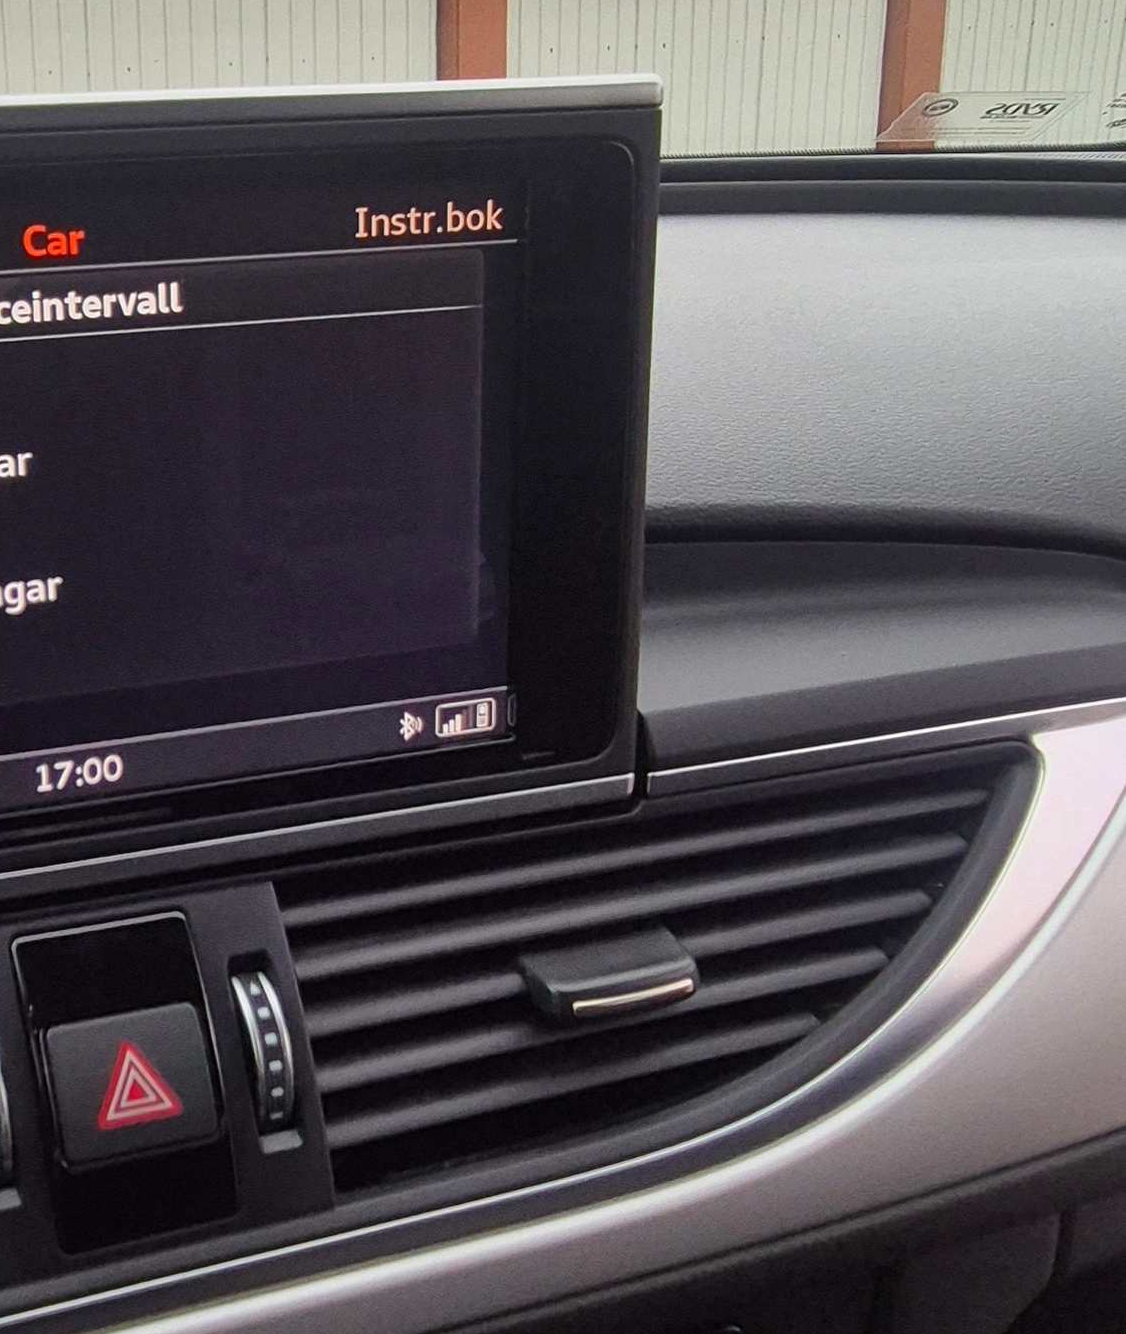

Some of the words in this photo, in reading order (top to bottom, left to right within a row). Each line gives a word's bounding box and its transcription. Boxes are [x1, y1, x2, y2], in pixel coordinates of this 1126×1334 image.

[355, 199, 503, 239] Instr.bok
[22, 224, 85, 258] Car
[34, 753, 125, 794] 17:00
